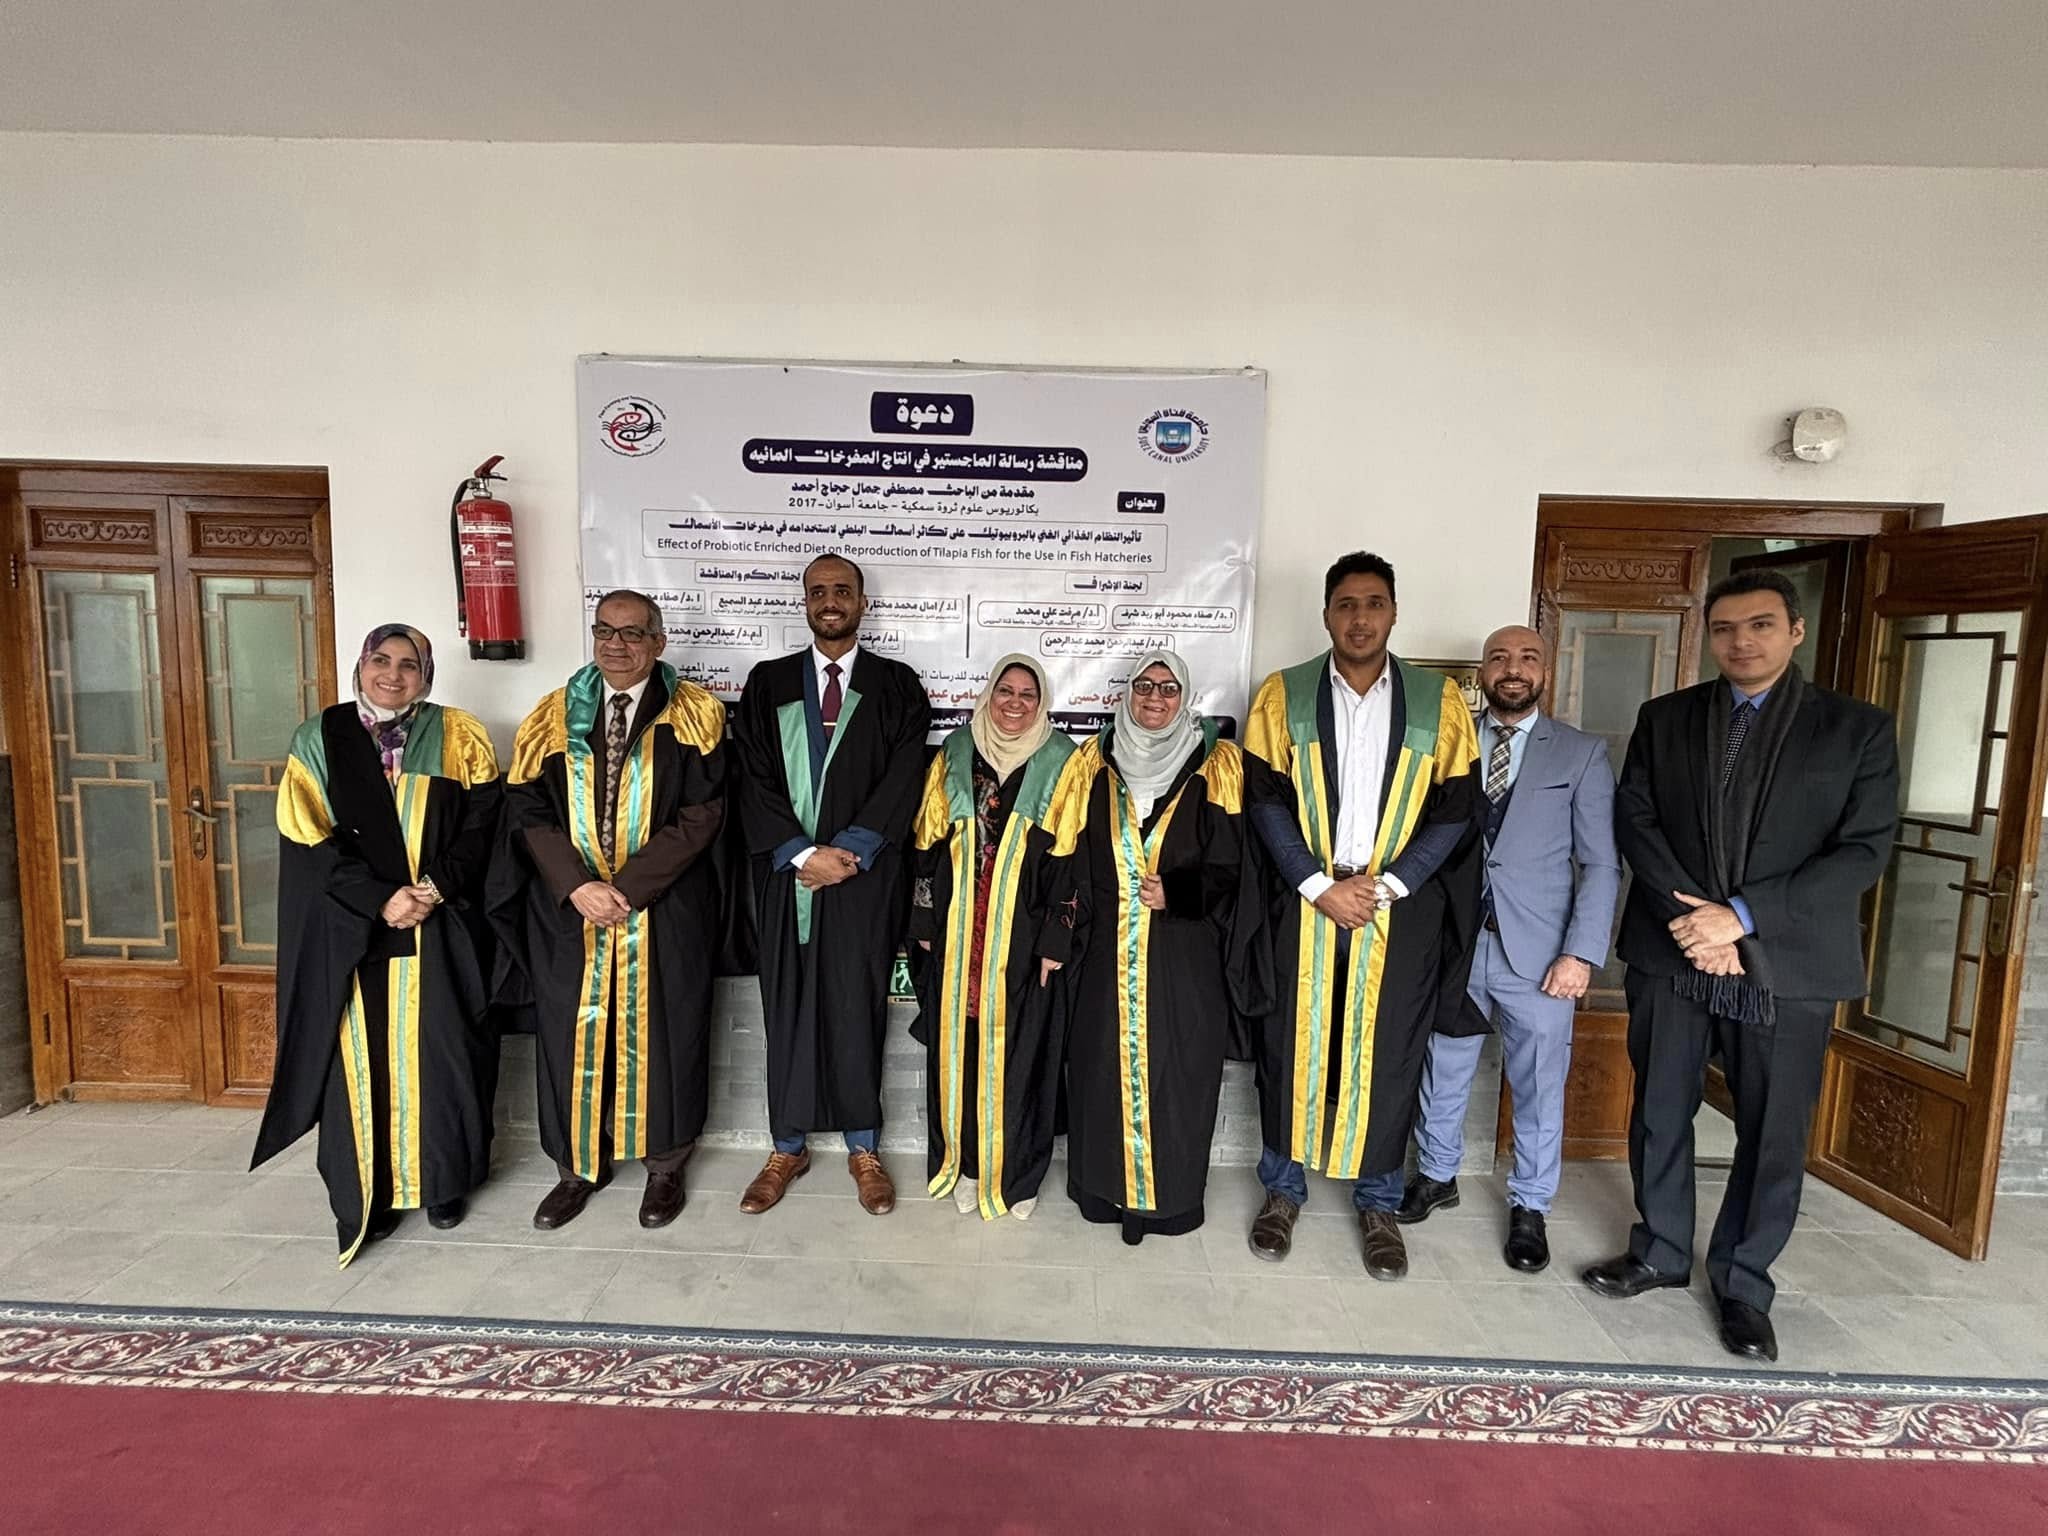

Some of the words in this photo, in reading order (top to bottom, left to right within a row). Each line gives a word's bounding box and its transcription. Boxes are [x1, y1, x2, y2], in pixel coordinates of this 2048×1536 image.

[896, 397, 955, 431] دعوة
[913, 448, 931, 473] في
[933, 452, 997, 471] الماجستير
[998, 452, 1035, 473] رسالة
[1036, 451, 1084, 471] مناقشة
[791, 478, 819, 493] أحمد
[851, 482, 881, 497] جمال
[1000, 485, 1035, 498] مقدمة
[980, 487, 998, 500] من
[857, 500, 889, 513] جامعة
[960, 503, 984, 516] علوم
[657, 538, 689, 550] Effect
[690, 539, 702, 551] of
[703, 540, 751, 553] Probiotic
[754, 541, 801, 554] Enriched
[803, 543, 826, 555] Diet
[844, 544, 918, 559] Reproduction
[919, 547, 932, 558] of
[933, 546, 969, 562] Tilapia
[970, 548, 993, 560] Fish
[994, 548, 1012, 561] for
[1013, 548, 1033, 561] the
[1034, 550, 1055, 562] Use
[1056, 551, 1068, 563] in
[1070, 551, 1093, 563] Fish
[1094, 551, 1153, 564] Hatcheries
[1122, 580, 1144, 592] لجنة
[707, 664, 730, 675] عميد
